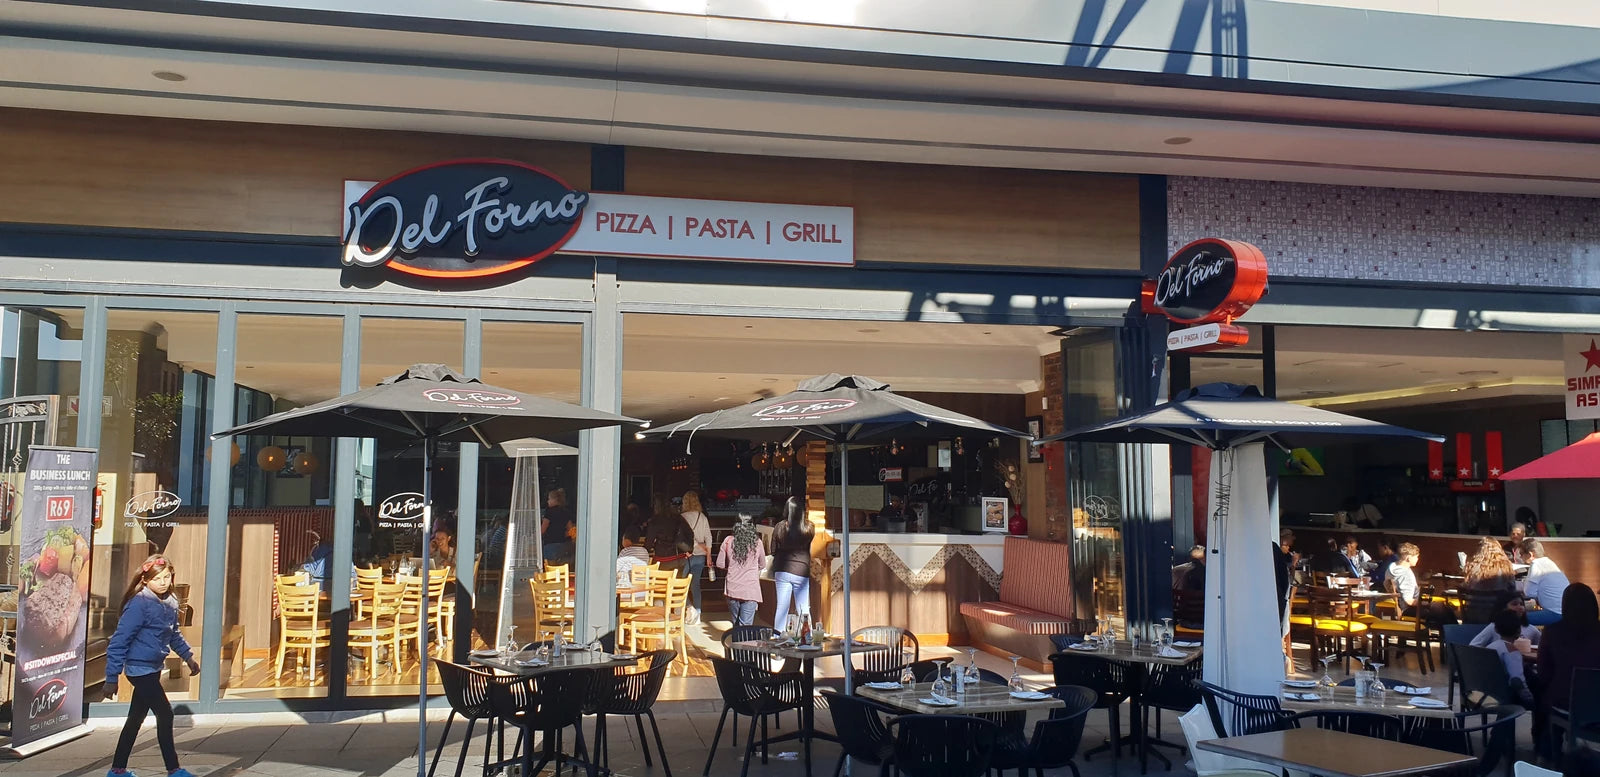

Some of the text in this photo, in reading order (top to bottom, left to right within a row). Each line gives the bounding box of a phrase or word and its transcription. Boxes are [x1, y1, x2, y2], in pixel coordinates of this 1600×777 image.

[344, 176, 588, 265] Del Forno
[596, 212, 842, 244] PIZZA PASTA GRILL
[1154, 253, 1224, 306] Del Forno
[1184, 333, 1199, 342] PASTA
[1204, 330, 1217, 339] GRILL
[56, 454, 71, 464] THE
[30, 470, 91, 481] BUSINESS LUNCH
[50, 500, 70, 517] R69
[126, 496, 179, 516] Del Forno
[381, 501, 403, 516] Del
[24, 650, 77, 671] #SITDOWNSPECIAL
[29, 684, 68, 719] Del Forno
